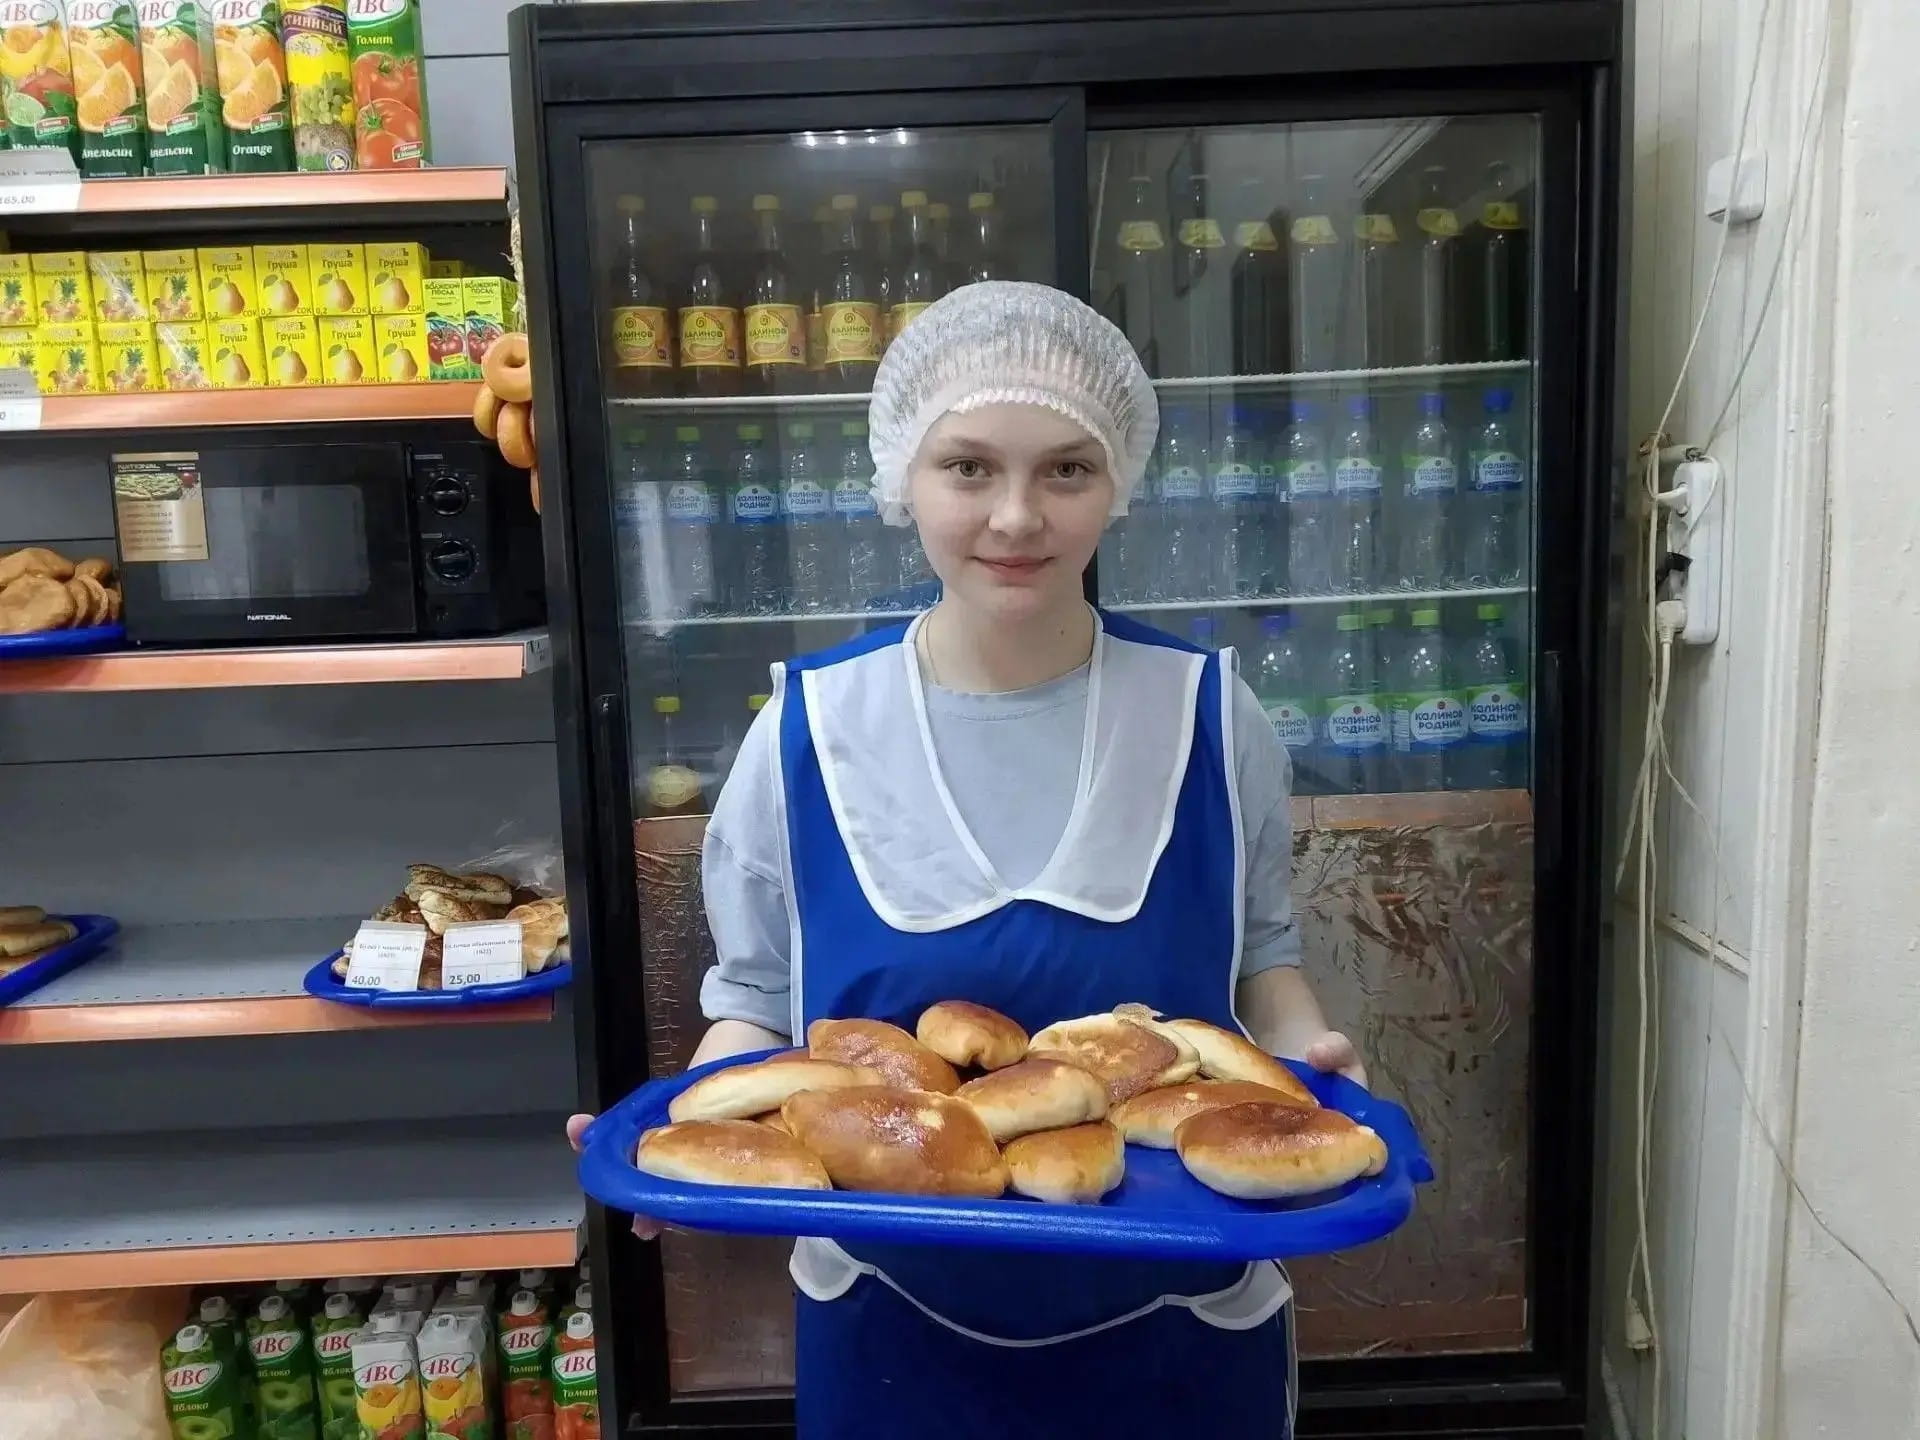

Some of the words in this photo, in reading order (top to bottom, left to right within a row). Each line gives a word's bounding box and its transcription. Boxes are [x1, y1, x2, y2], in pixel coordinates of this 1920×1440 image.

[356, 35, 393, 45] Томат
[232, 144, 273, 156] Orange
[212, 263, 242, 272] Груша
[267, 260, 297, 271] Груша
[322, 259, 353, 269] Груша
[379, 258, 409, 268] Груша
[220, 333, 248, 343] Груша
[276, 332, 305, 343] Груша
[332, 330, 361, 340] Груша
[388, 329, 417, 339] Груша
[1473, 712, 1519, 722] РОДНИК
[1271, 718, 1308, 728] ЛИНОВ
[1418, 720, 1462, 729] РОДНИК
[1278, 727, 1305, 737] ДНИК
[1335, 725, 1380, 734] РОДНИК
[352, 975, 381, 987] 40,00
[449, 973, 481, 985] 25,00
[254, 1335, 291, 1354] ABC
[320, 1332, 354, 1352] ABC
[505, 1330, 545, 1349] ABC
[424, 1357, 465, 1375] ABC
[168, 1367, 210, 1387] ABC
[360, 1364, 403, 1383] ABC
